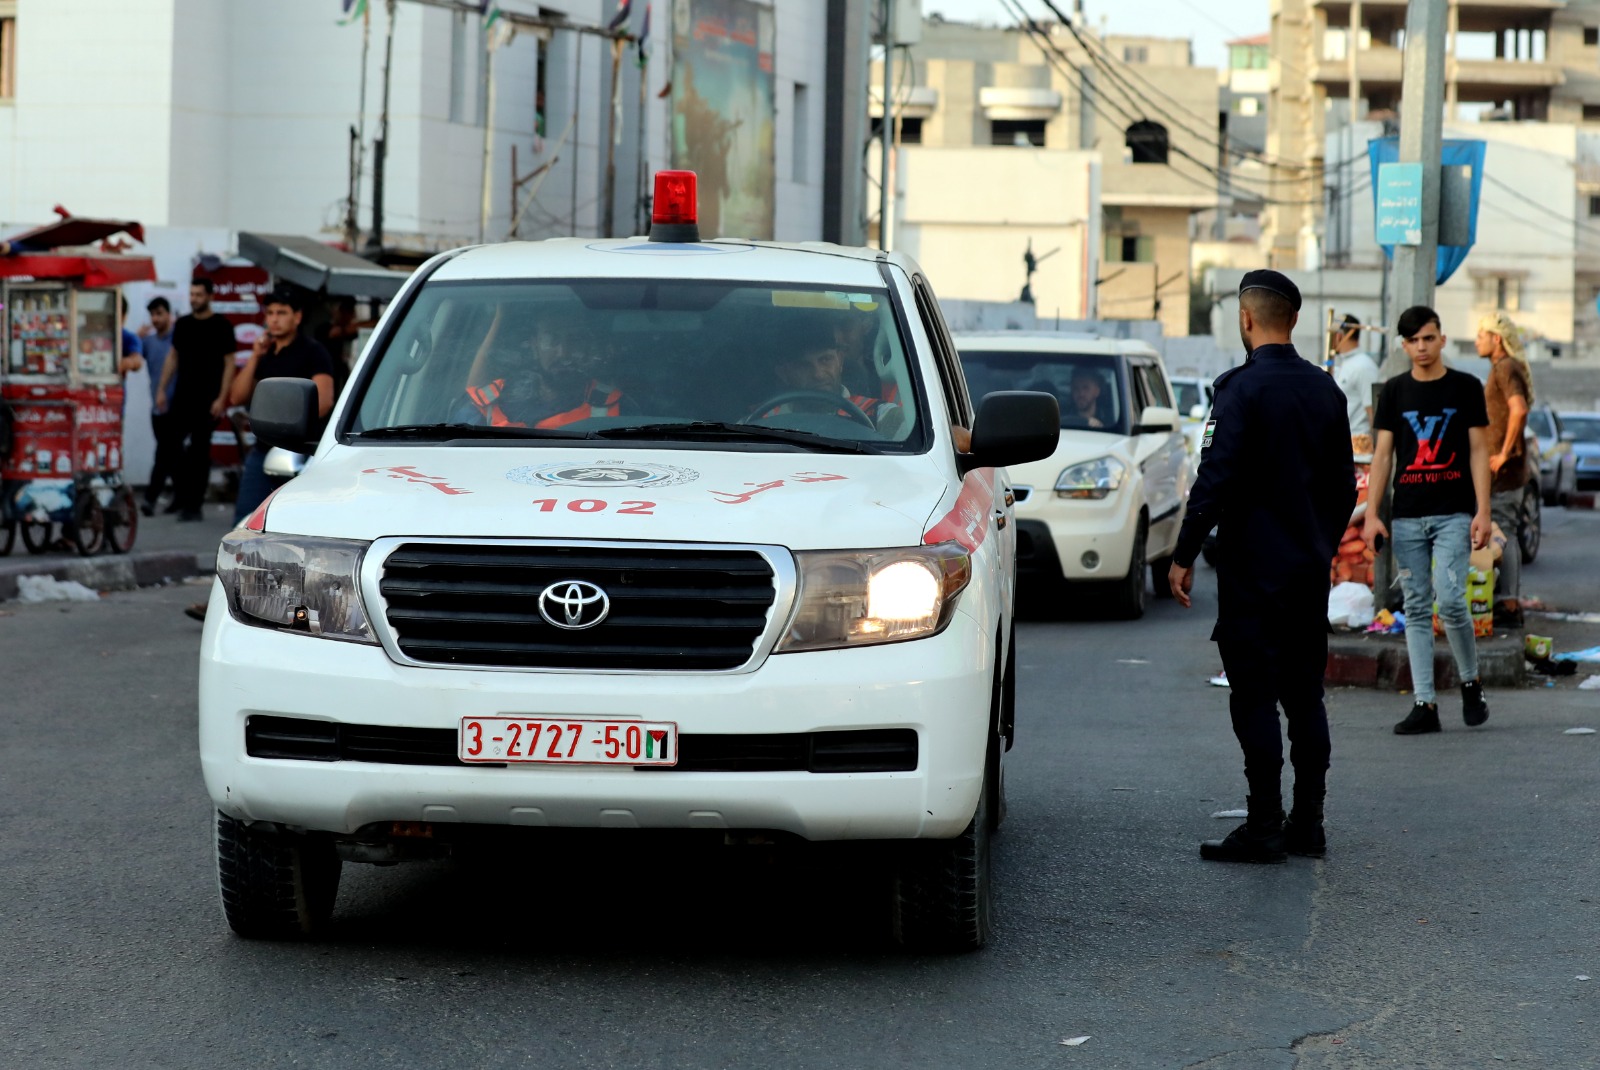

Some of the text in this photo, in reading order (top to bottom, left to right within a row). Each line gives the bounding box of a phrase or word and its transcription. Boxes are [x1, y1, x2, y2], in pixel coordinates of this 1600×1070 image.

[1399, 470, 1461, 484] LOUIS VUTON
[532, 498, 657, 515] 102
